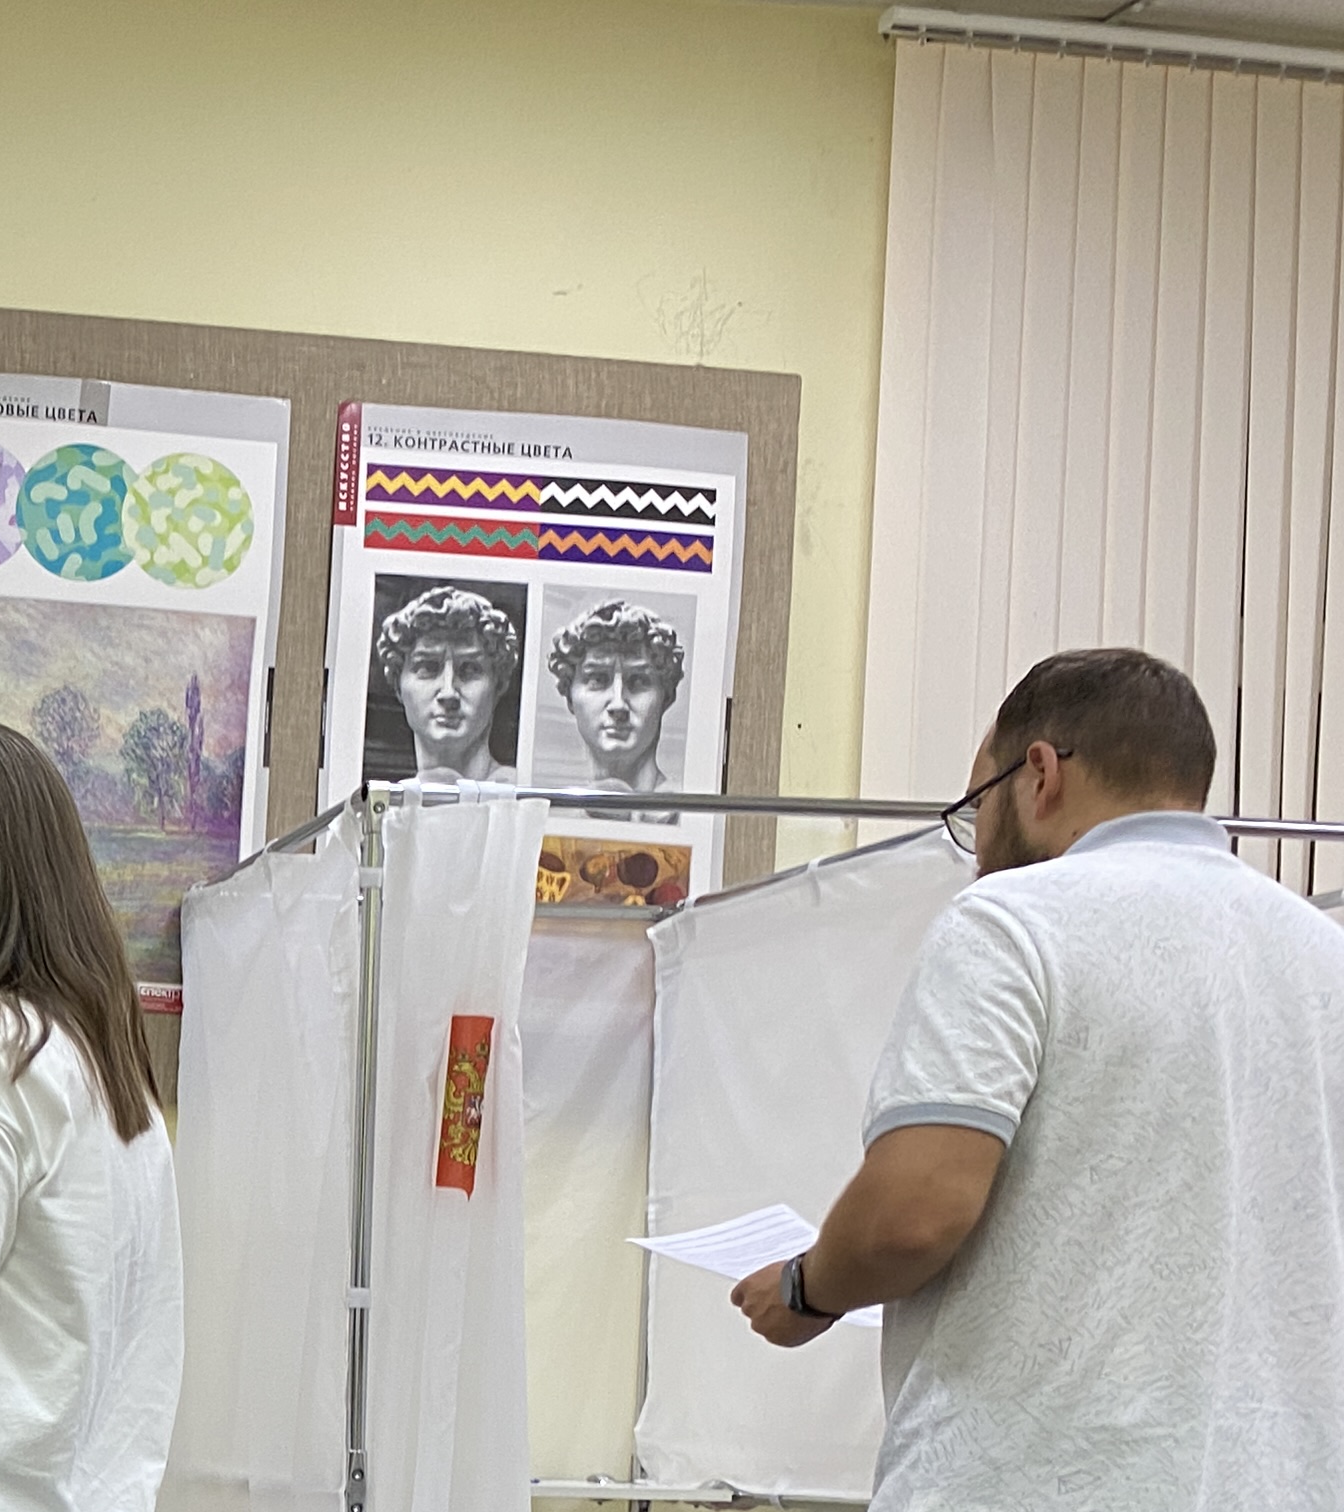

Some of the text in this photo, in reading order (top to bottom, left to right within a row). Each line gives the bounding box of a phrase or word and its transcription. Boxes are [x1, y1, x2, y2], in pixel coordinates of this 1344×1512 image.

[45, 406, 98, 424] ЦВЕТА
[368, 433, 573, 460] 12. КОНТРАСТНЫЕ ЦВЕТА
[338, 422, 352, 512] ИСКУССТВО
